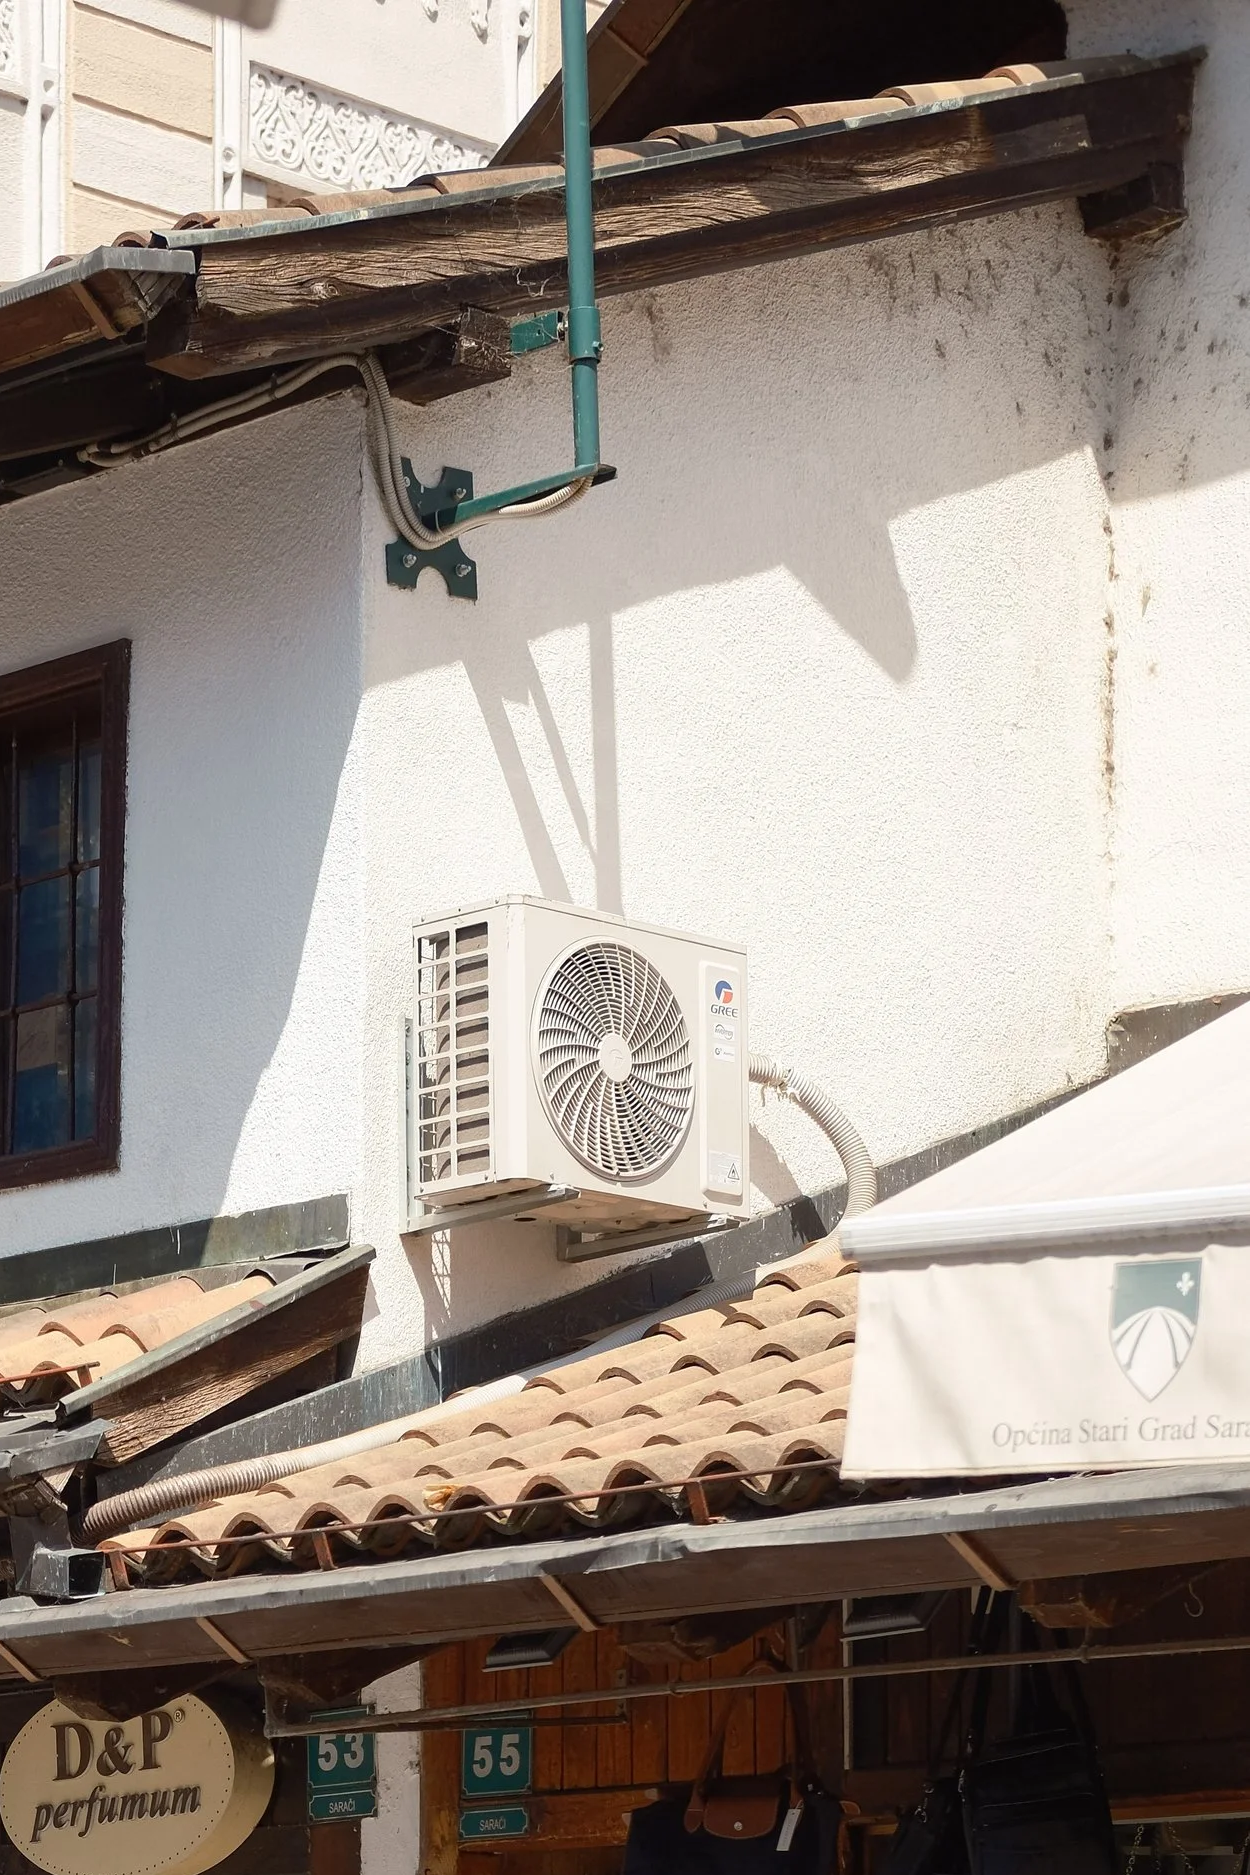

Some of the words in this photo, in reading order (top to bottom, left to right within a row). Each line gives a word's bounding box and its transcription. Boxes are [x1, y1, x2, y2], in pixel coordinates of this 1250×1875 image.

[710, 1003, 739, 1018] GREE
[992, 1422, 1072, 1453] Općina
[1078, 1416, 1129, 1444] Stari
[1138, 1415, 1198, 1442] Grad
[317, 1733, 364, 1772] 53
[472, 1733, 520, 1778] 55
[30, 1784, 202, 1843] perfumum
